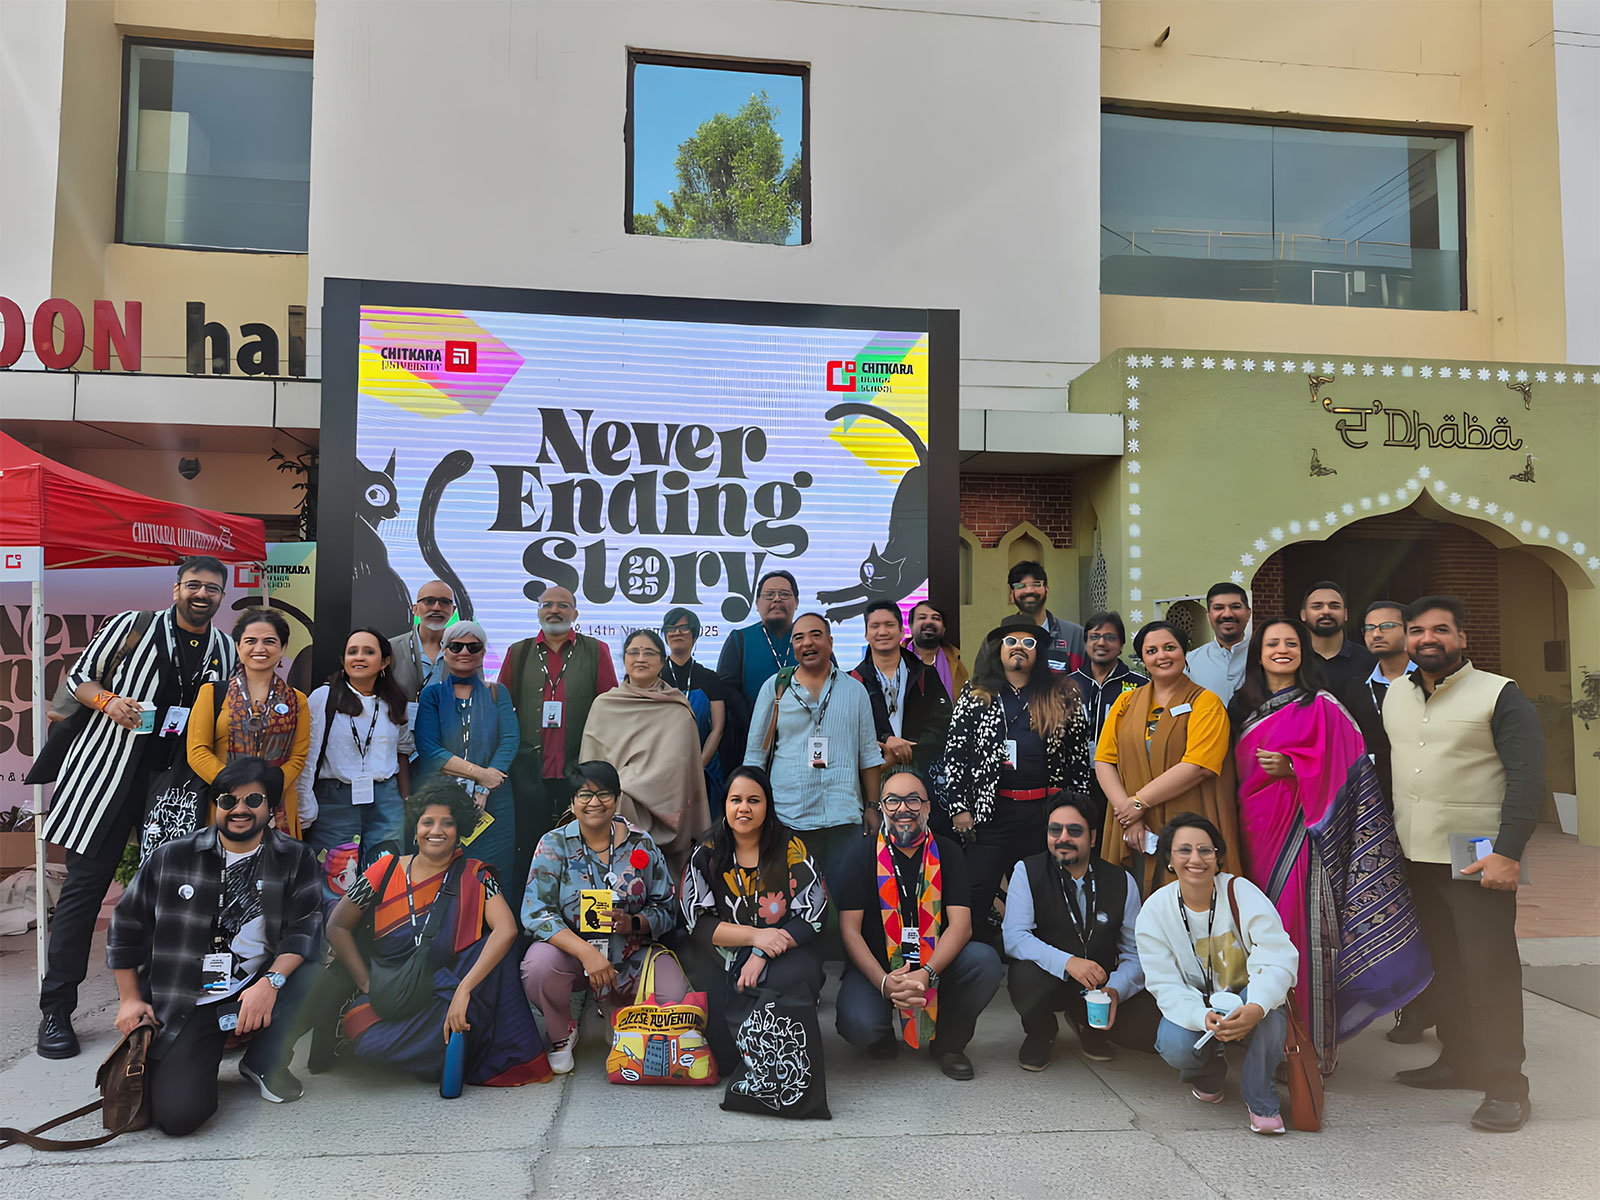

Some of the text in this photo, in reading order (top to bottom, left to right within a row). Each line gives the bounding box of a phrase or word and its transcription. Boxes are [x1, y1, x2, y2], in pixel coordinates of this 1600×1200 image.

[381, 347, 442, 361] CHITKARA
[862, 362, 913, 375] CHITKARA
[535, 408, 767, 479] Never
[487, 464, 813, 558] Ending
[522, 536, 767, 623] Story
[589, 625, 616, 636] 14th
